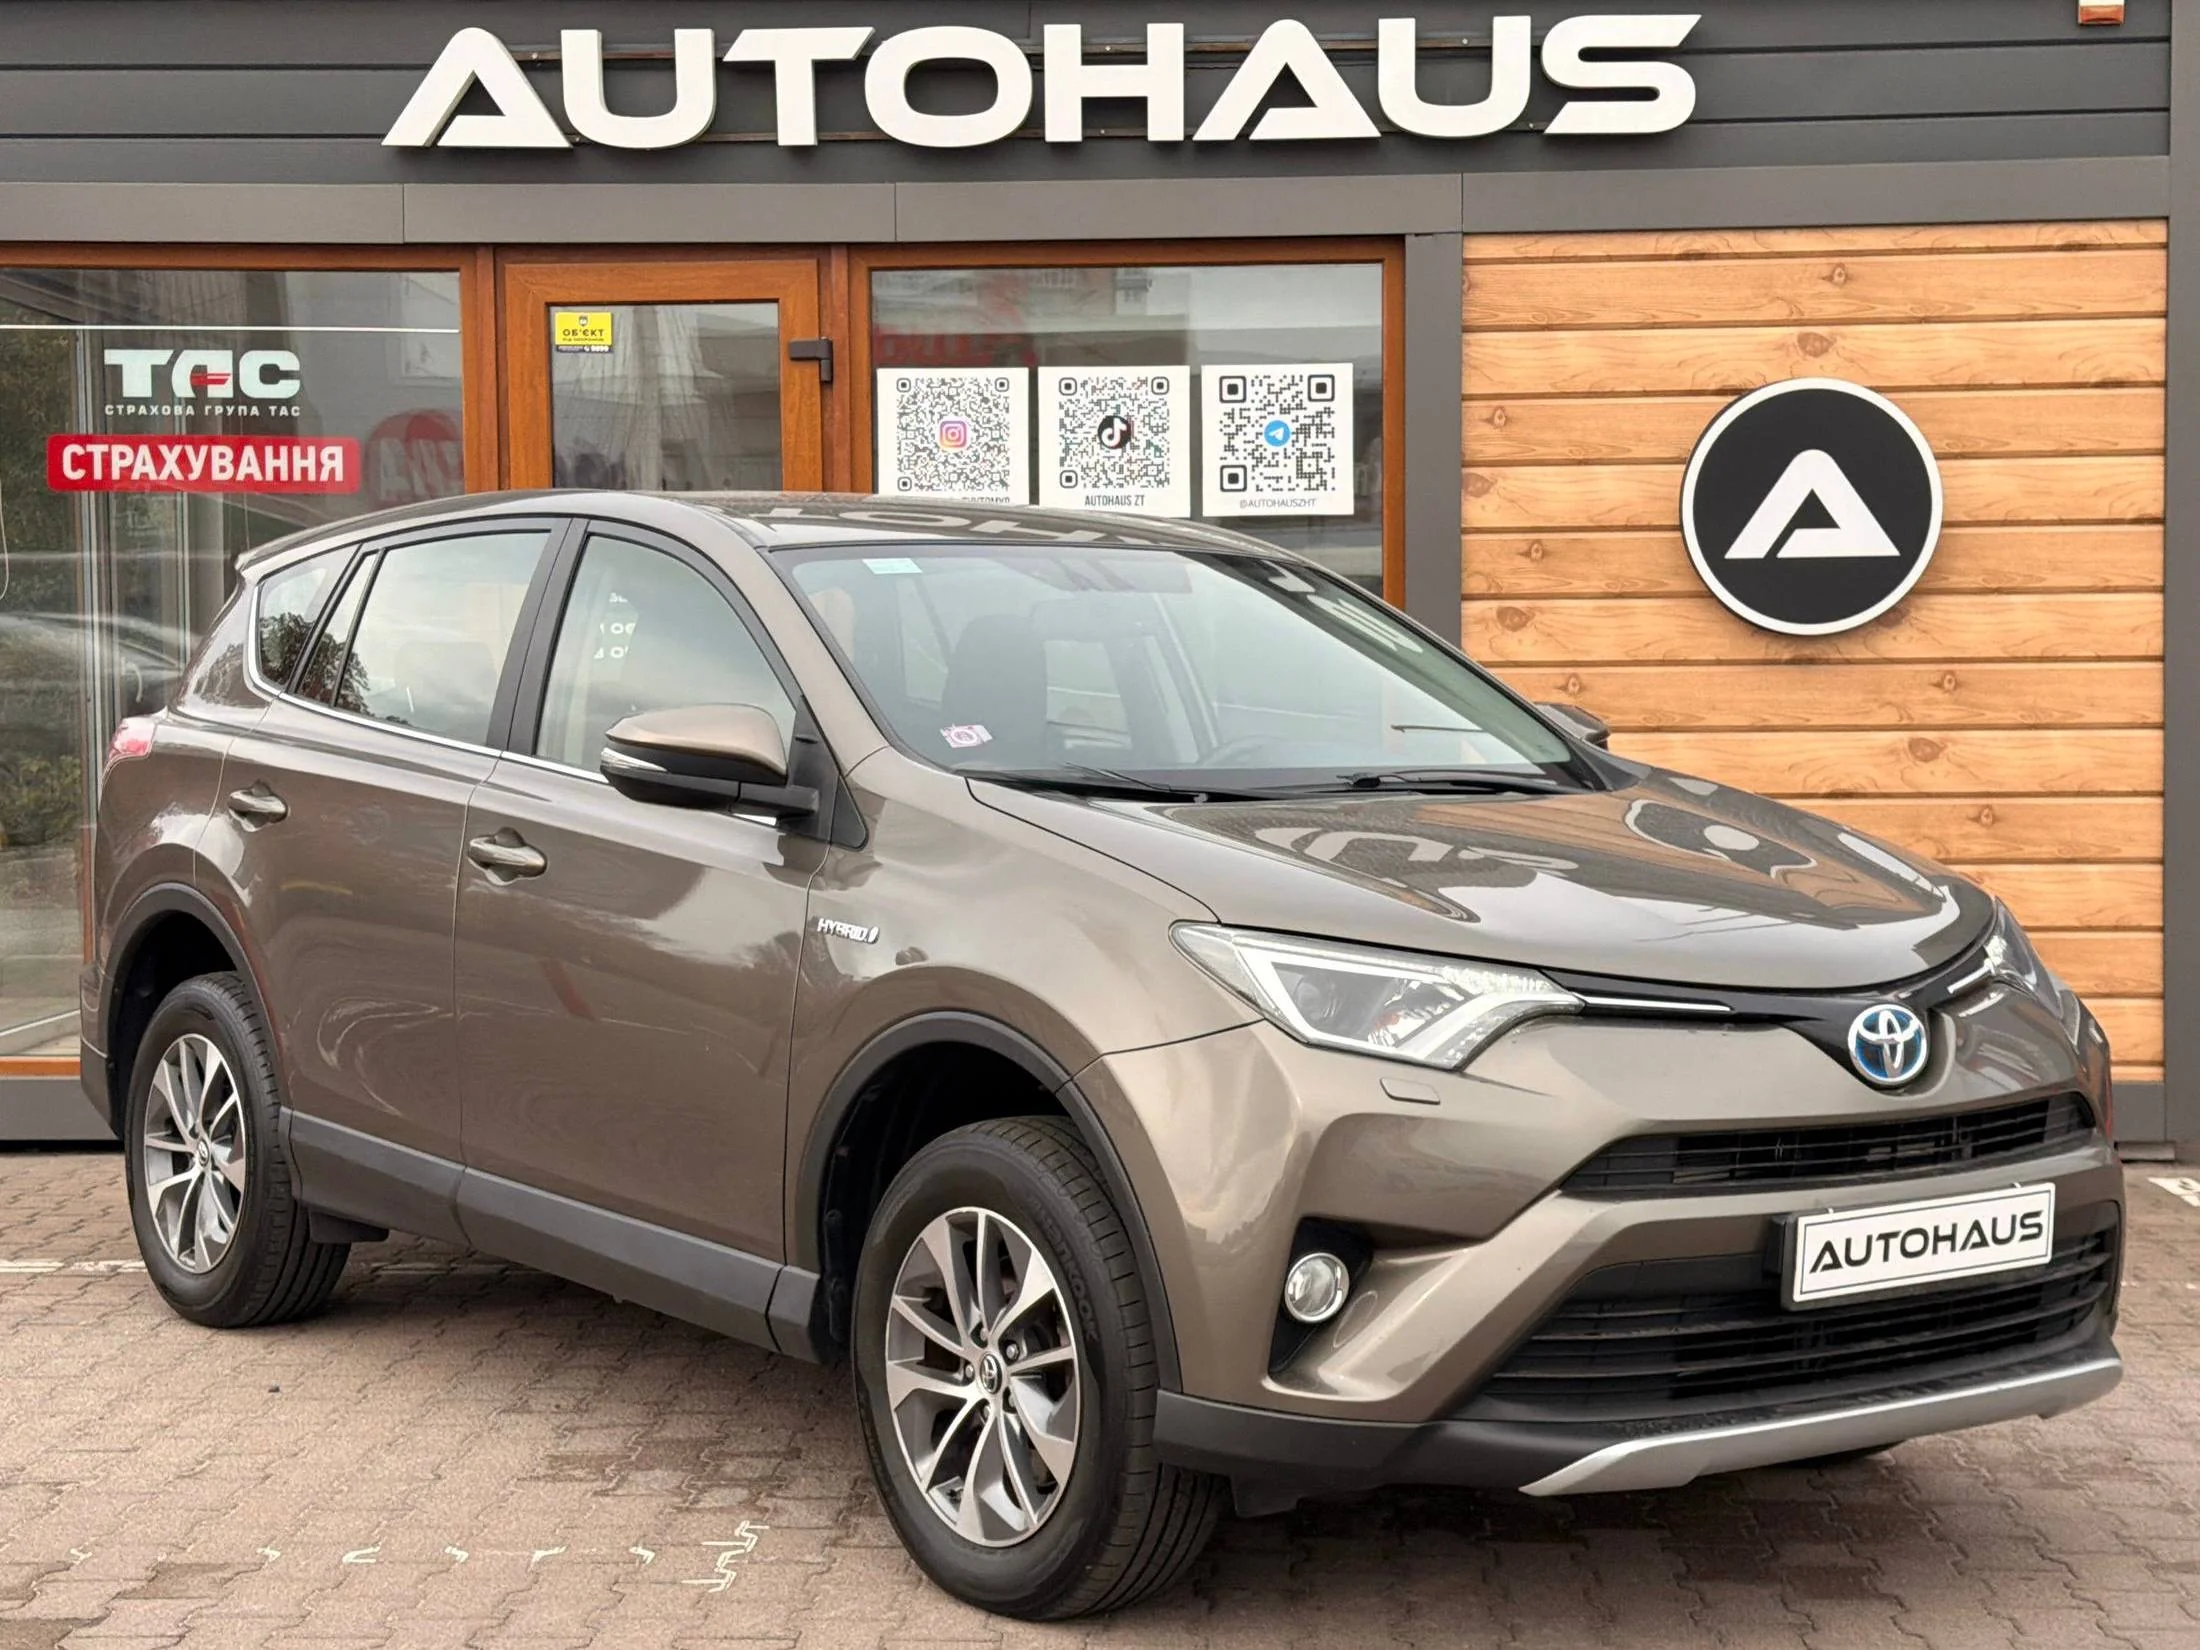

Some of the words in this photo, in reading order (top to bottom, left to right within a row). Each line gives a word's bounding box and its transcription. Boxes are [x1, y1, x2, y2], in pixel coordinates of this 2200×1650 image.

[382, 14, 1702, 149] AUTOHAUS
[104, 404, 195, 416] СТРАХОВА
[204, 405, 260, 417] ГРУПА
[269, 406, 300, 417] ТАС
[62, 443, 344, 482] СТРАХУВАННЯ
[1084, 494, 1132, 506] AUTOHAUS
[1134, 494, 1145, 507] ZT
[816, 918, 868, 942] HYBRID
[1809, 1210, 2043, 1274] AUTOHAUS
